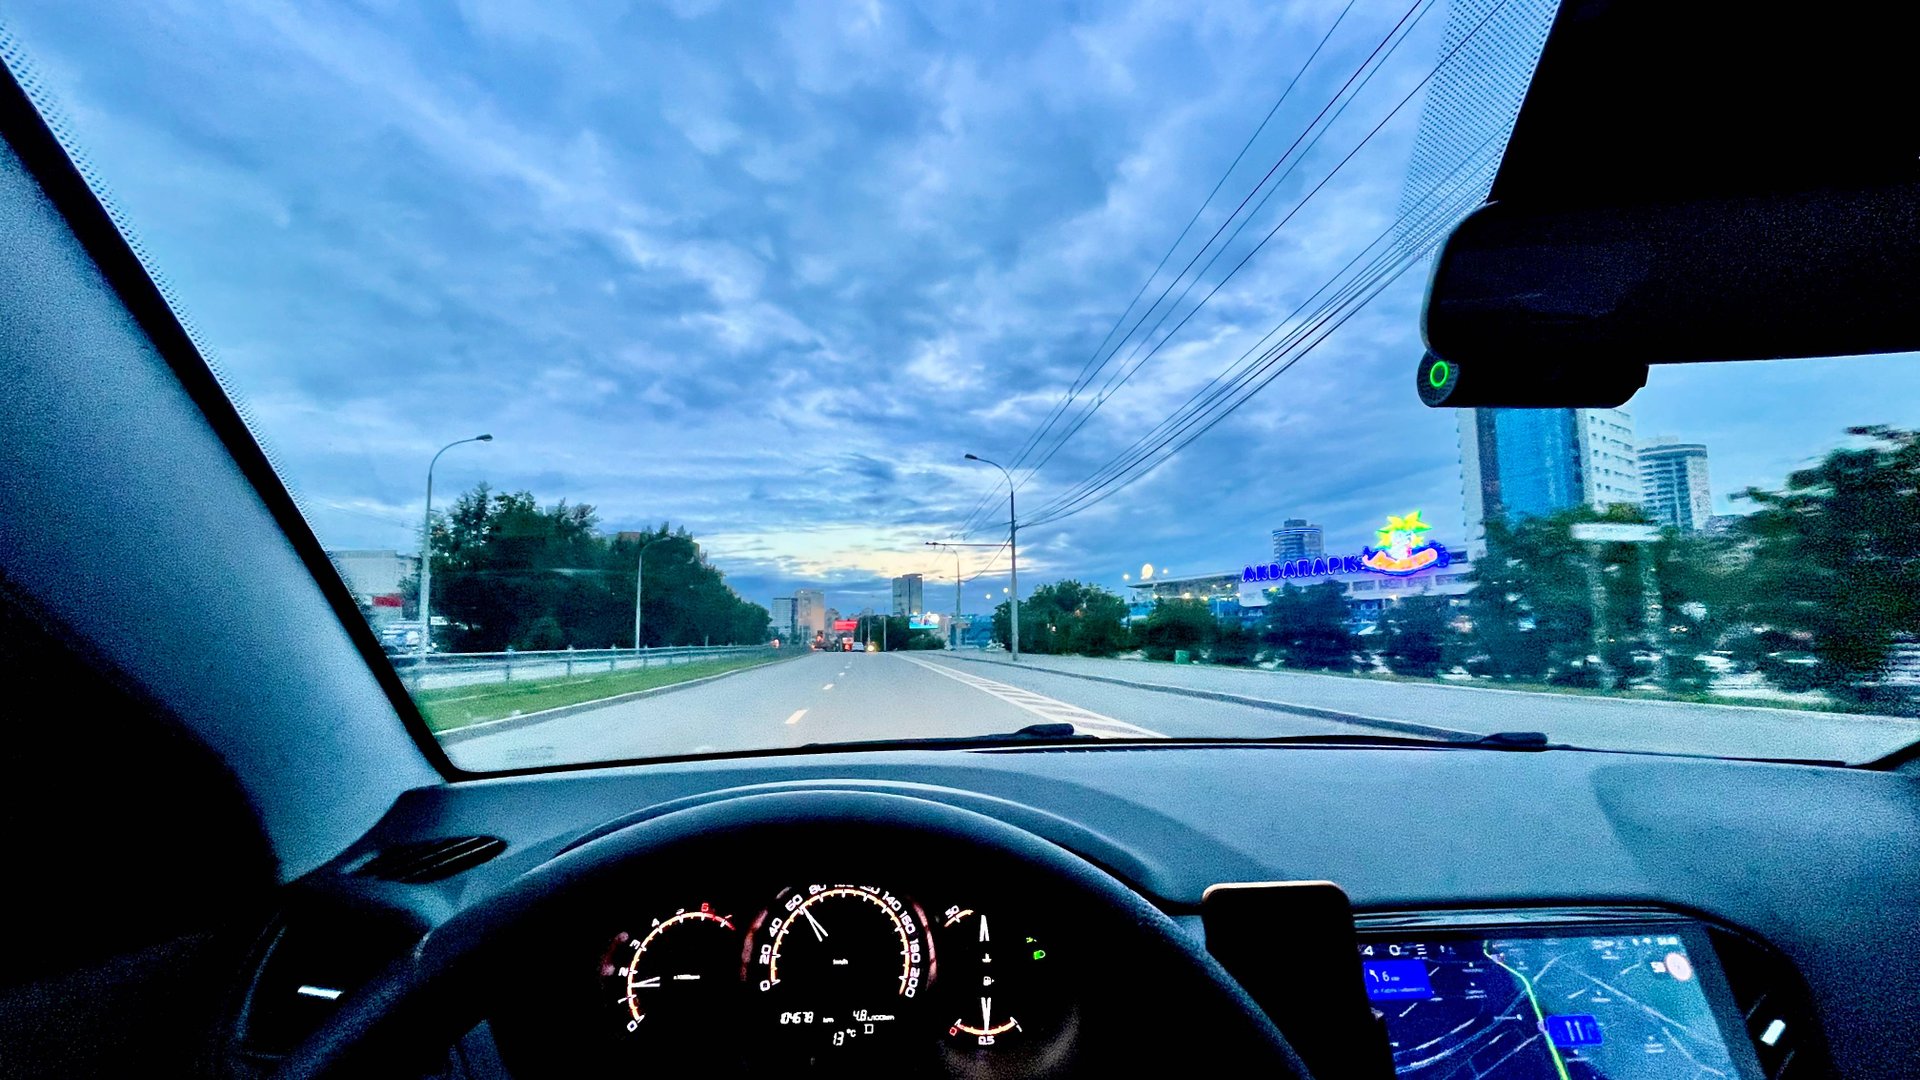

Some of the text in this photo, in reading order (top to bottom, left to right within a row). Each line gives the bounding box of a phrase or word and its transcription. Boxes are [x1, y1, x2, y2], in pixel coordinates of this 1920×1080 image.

[1242, 555, 1358, 582] АКВАПАРК
[785, 894, 803, 912] 60
[882, 891, 902, 911] 140
[769, 917, 783, 938] 40
[899, 911, 916, 935] 160
[629, 939, 641, 950] 3
[758, 944, 772, 965] 20
[909, 938, 921, 963] 180
[618, 967, 629, 977] 2
[759, 980, 770, 992] 0
[905, 967, 920, 998] 200
[627, 1020, 638, 1032] 0
[833, 1031, 844, 1046] 13
